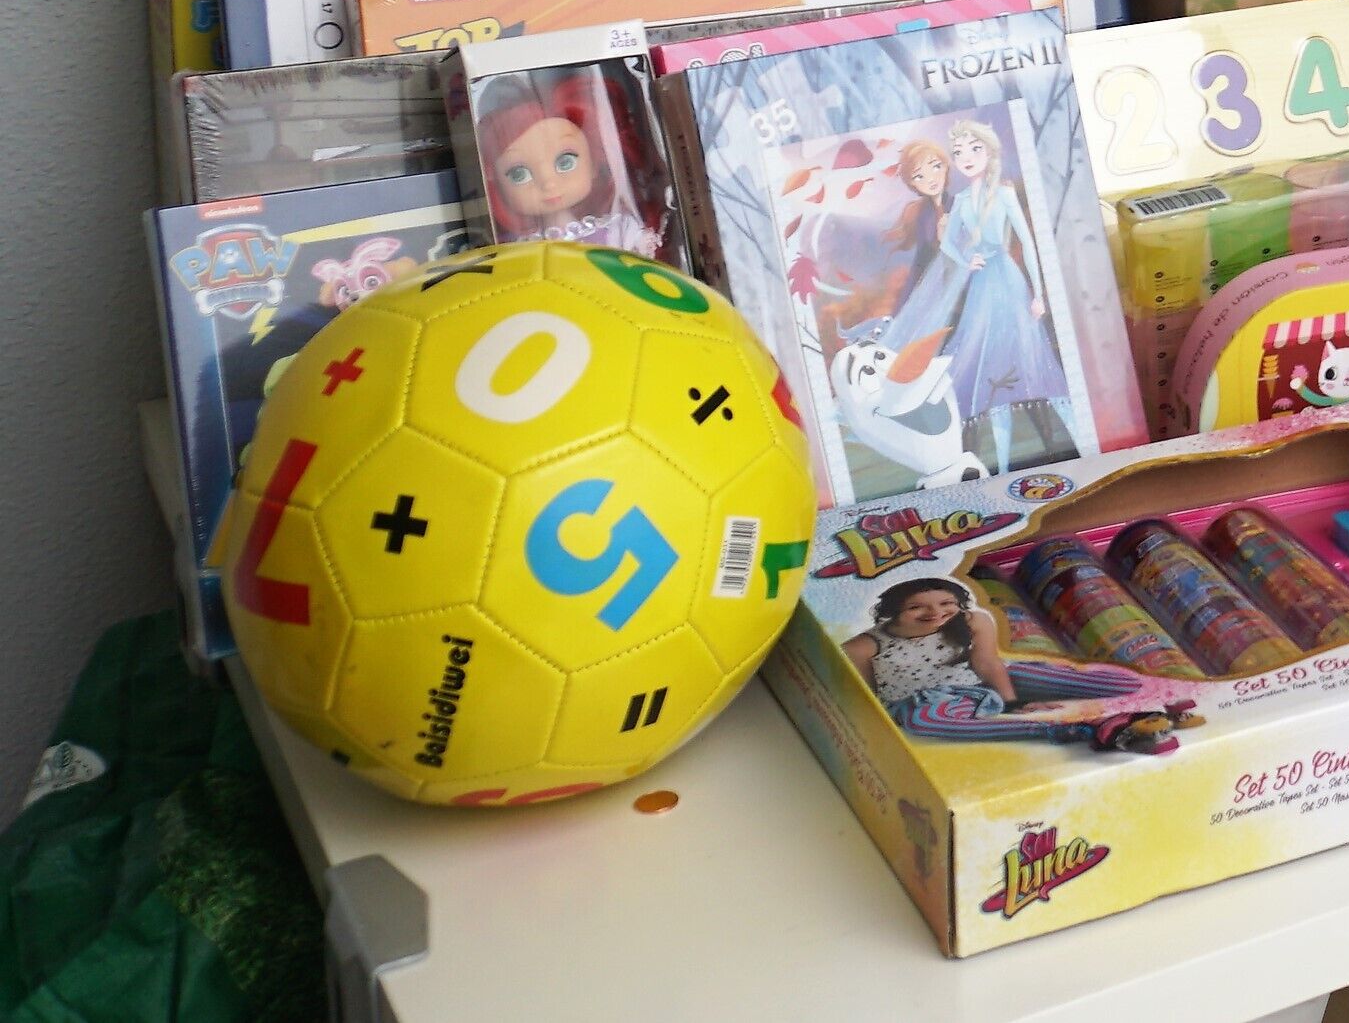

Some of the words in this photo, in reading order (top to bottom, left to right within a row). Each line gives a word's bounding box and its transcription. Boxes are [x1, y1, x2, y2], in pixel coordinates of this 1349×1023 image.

[322, 2, 333, 15] 17
[920, 47, 1036, 91] FROZEN
[1036, 41, 1064, 67] II
[748, 97, 799, 149] 35
[1096, 65, 1179, 175] 2
[1192, 52, 1264, 155] 3
[169, 224, 301, 284] PAW
[455, 311, 592, 424] 0
[524, 478, 680, 633] 5
[415, 633, 476, 769] Baisidiwei
[1232, 677, 1271, 697] Set
[1274, 668, 1308, 684] 50
[1233, 773, 1267, 804] Set
[1272, 761, 1304, 791] 50
[1299, 800, 1315, 816] Set
[1316, 797, 1330, 811] 50
[1209, 812, 1224, 826] 50
[1002, 836, 1090, 919] Luna
